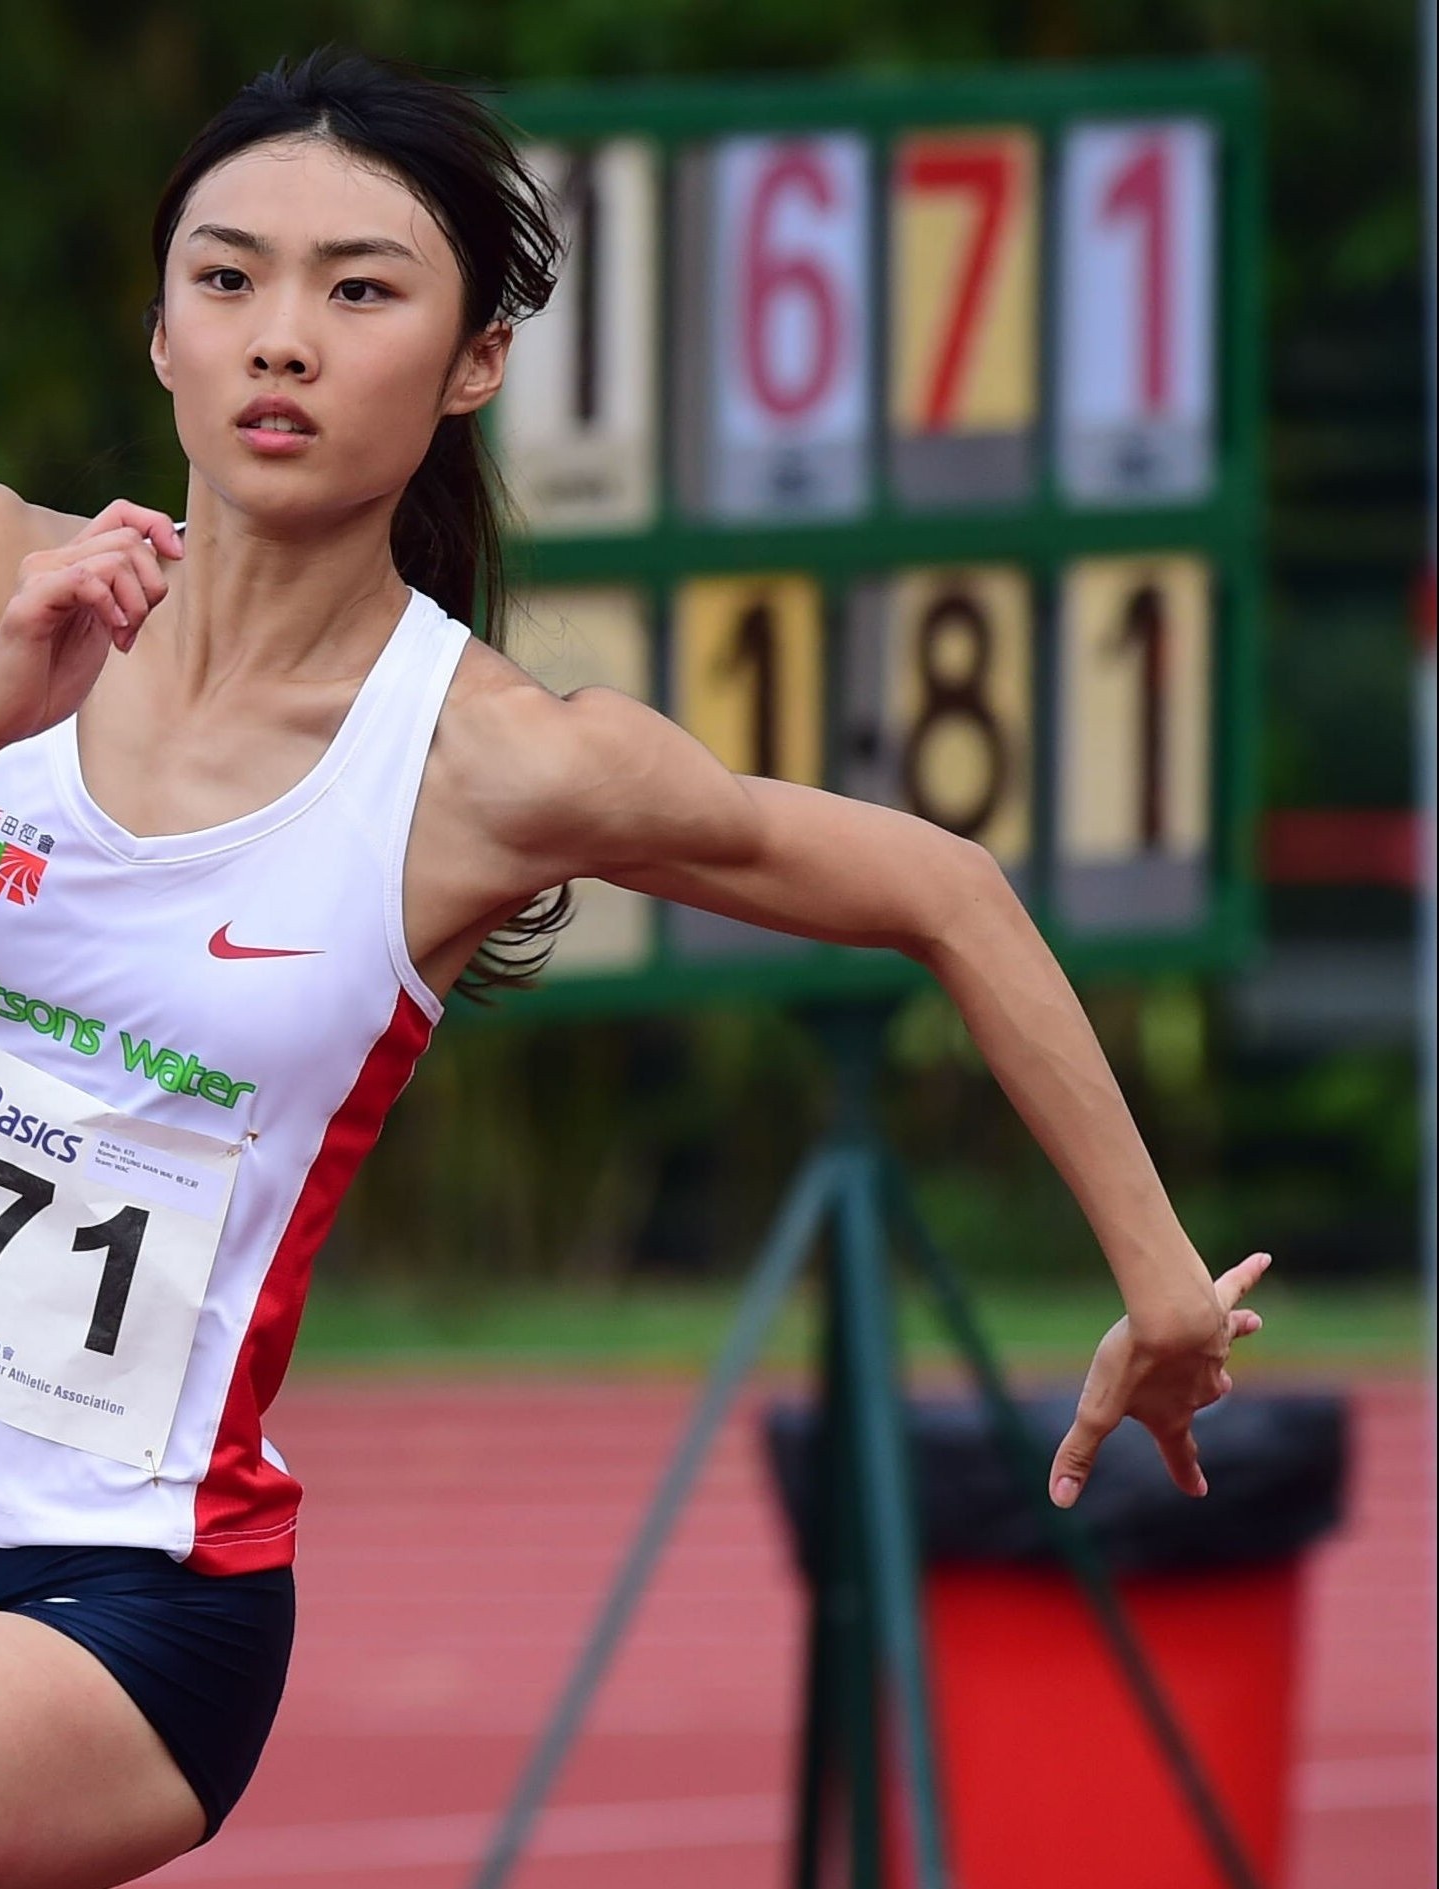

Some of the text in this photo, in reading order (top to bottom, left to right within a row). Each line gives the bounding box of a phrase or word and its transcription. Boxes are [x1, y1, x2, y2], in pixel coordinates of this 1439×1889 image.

[739, 138, 1178, 434] 671
[8, 1367, 52, 1394] Athletic
[53, 1384, 126, 1416] Association
